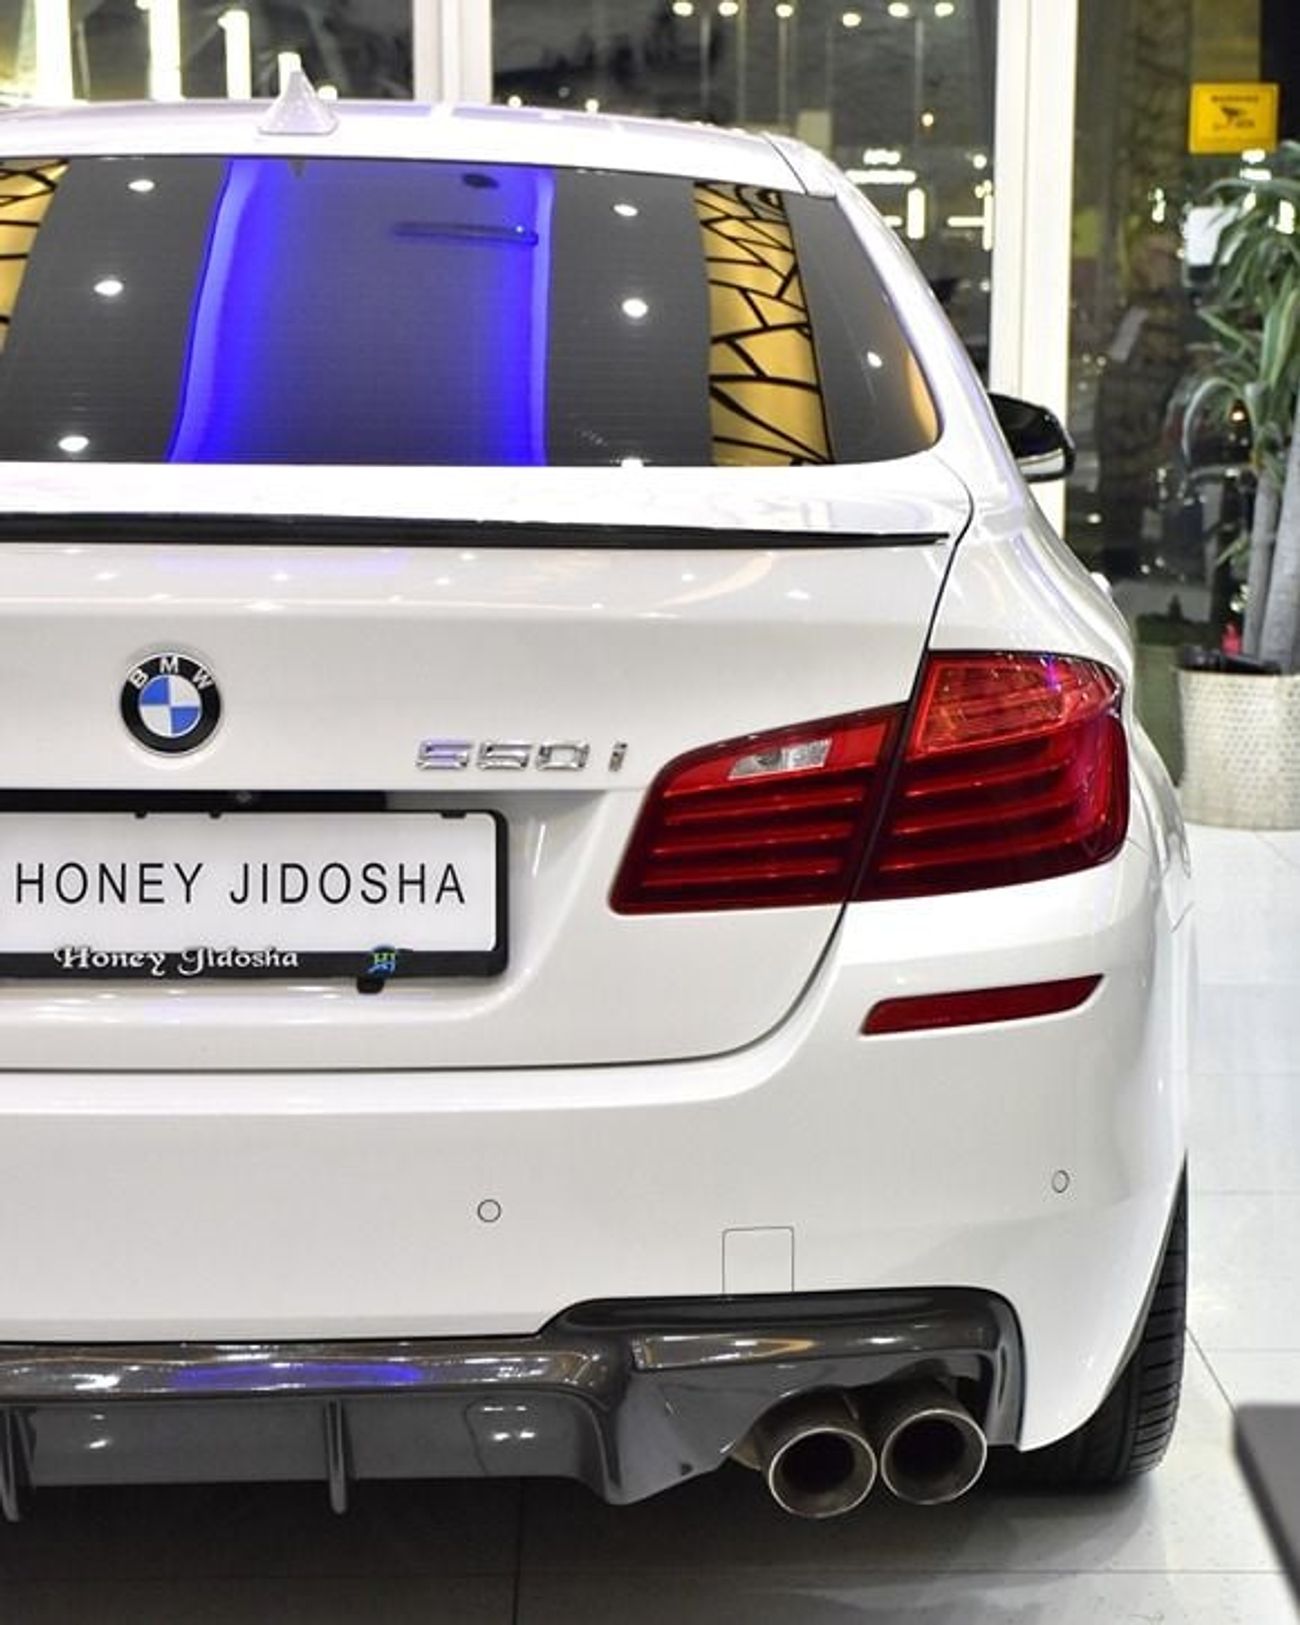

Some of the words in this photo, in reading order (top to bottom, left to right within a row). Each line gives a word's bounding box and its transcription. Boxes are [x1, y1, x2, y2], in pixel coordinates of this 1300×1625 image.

[129, 656, 214, 689] BMW
[16, 862, 203, 904] HONEY
[229, 862, 466, 904] JIDOSHA
[53, 946, 166, 976] Honey
[177, 946, 299, 976] Jidosha
